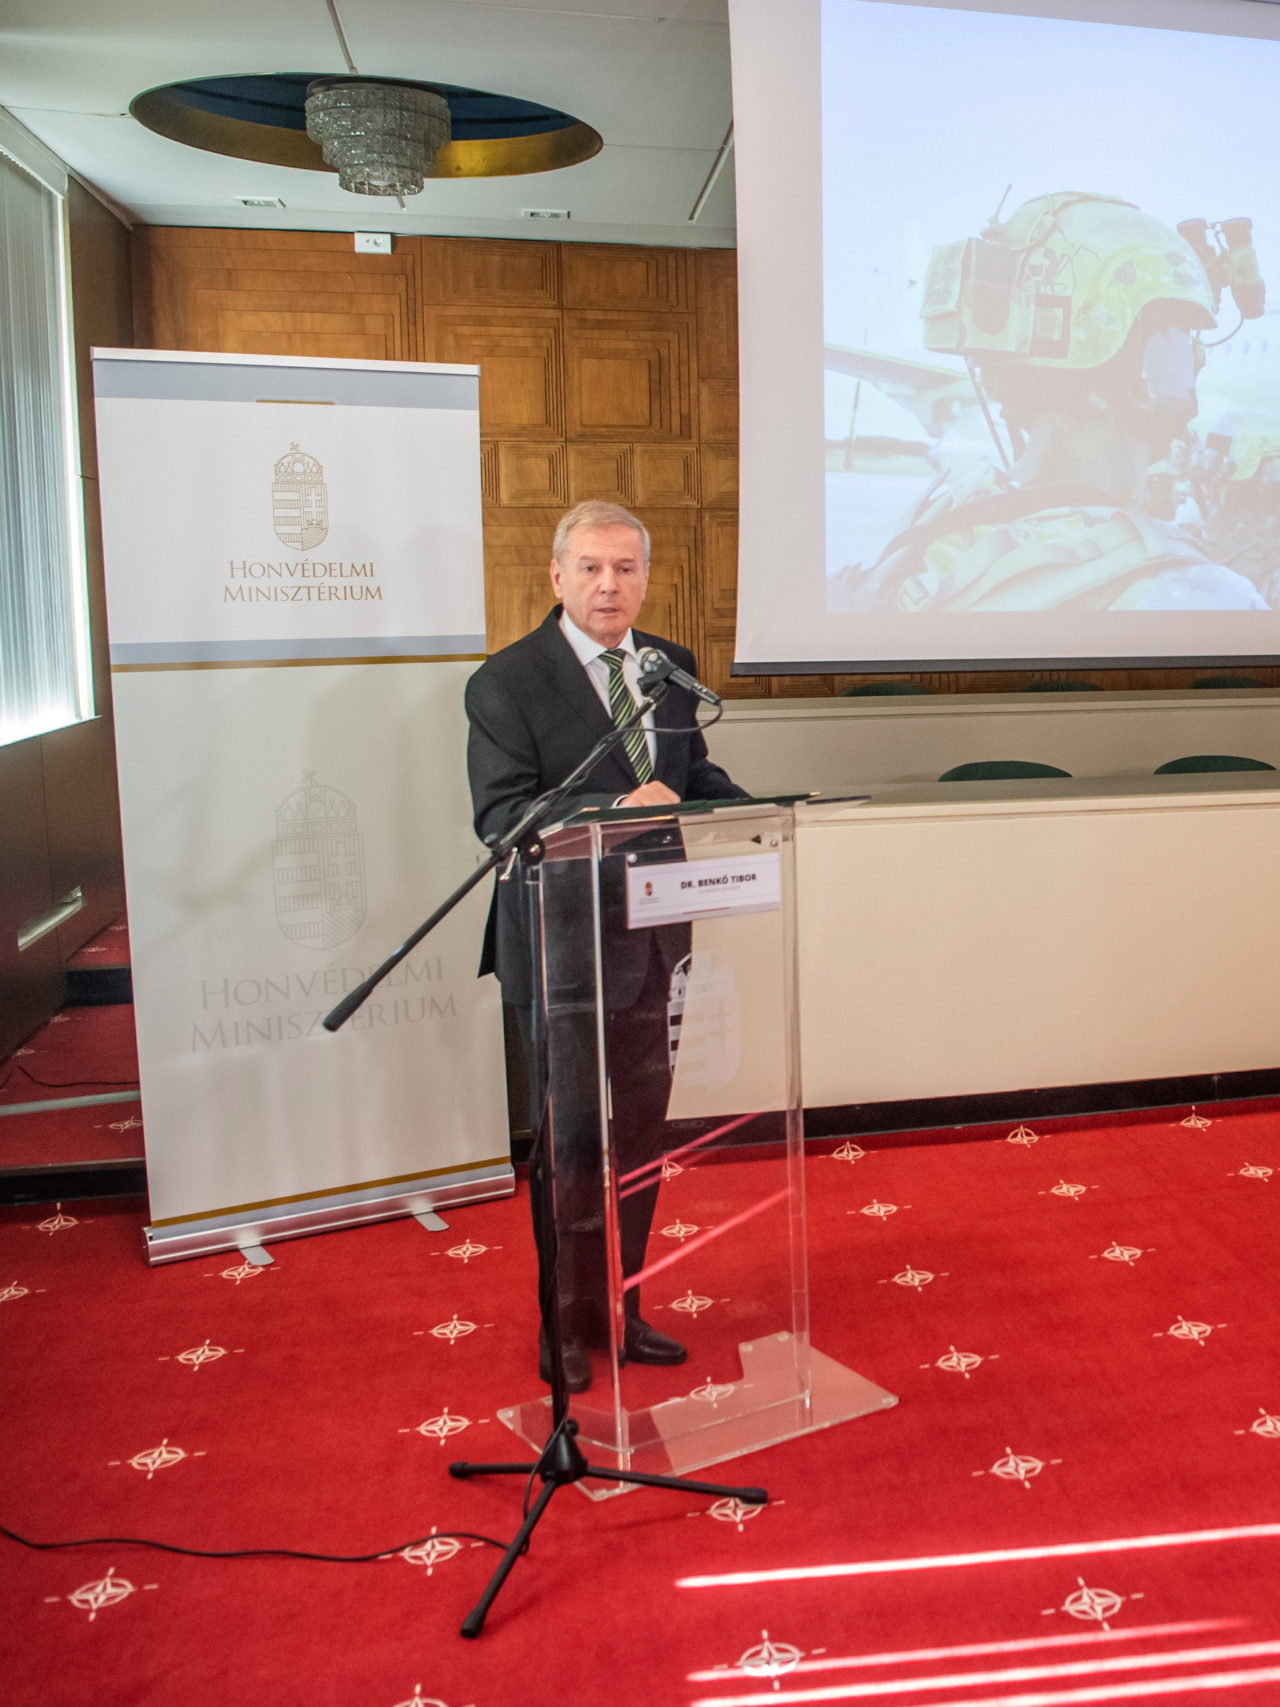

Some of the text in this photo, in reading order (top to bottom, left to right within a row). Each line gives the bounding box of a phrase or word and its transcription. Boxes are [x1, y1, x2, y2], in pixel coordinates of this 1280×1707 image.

[229, 559, 376, 579] HONVÉDELMI
[223, 583, 383, 603] MINISZTÉRIUM
[680, 880, 696, 890] DR.
[731, 873, 757, 884] TIBOR
[192, 993, 457, 1053] MINISZRIUM
